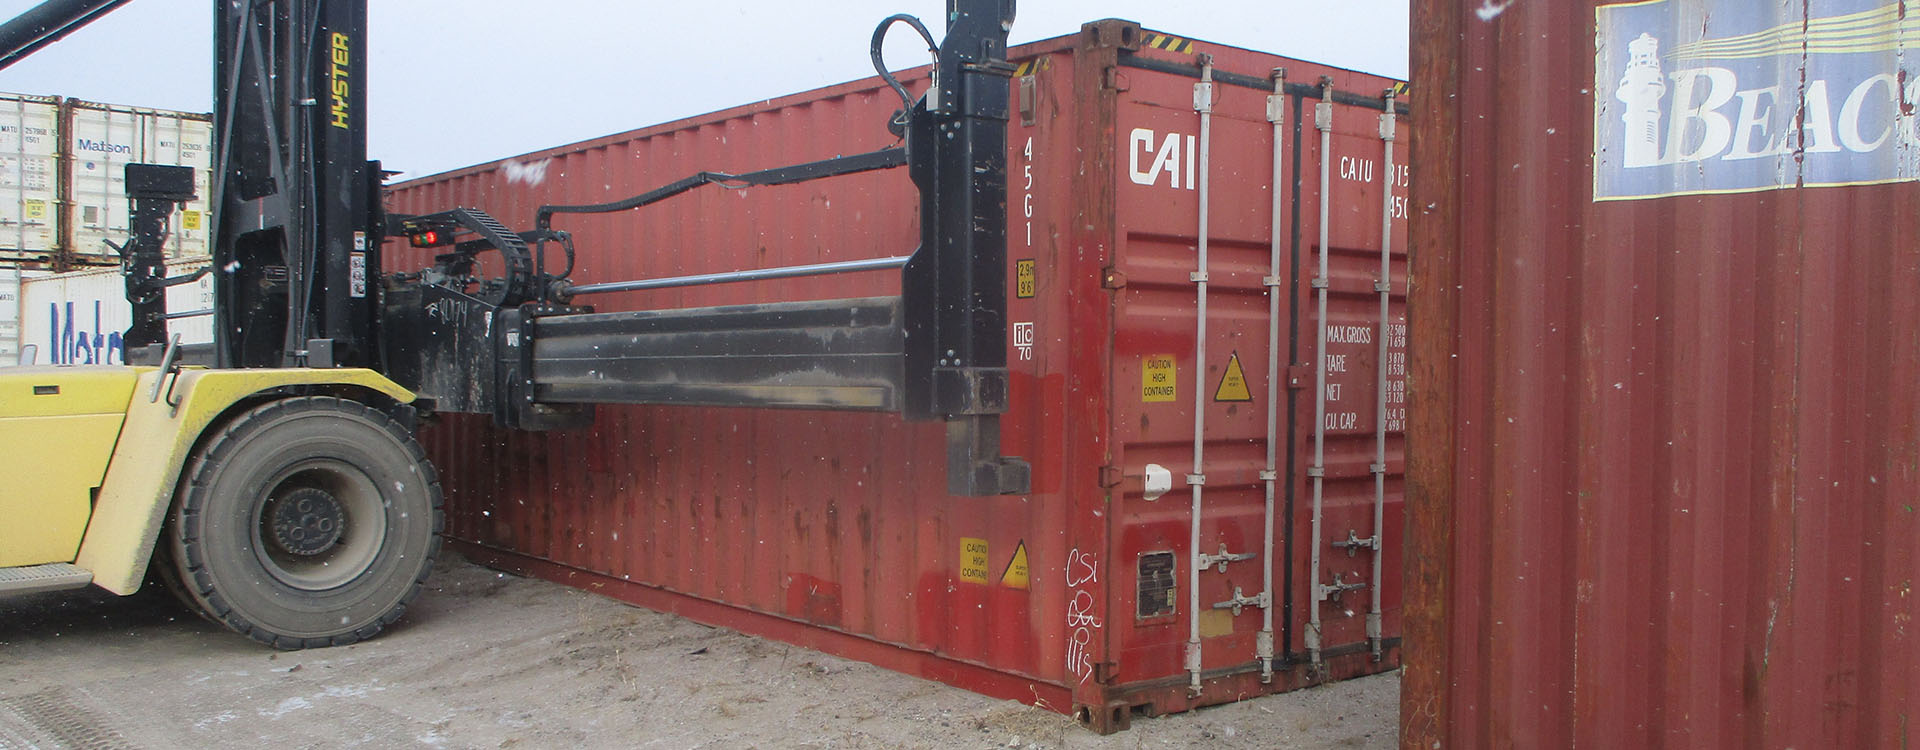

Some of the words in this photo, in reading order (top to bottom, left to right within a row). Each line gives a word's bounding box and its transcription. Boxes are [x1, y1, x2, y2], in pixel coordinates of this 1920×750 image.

[331, 32, 349, 129] HYSTER
[79, 139, 131, 155] Matson
[1129, 128, 1195, 190] CAI
[1340, 156, 1373, 183] CAIU
[1018, 346, 1032, 360] 70
[1147, 360, 1171, 369] CAUTION
[1327, 354, 1346, 372] TARE
[1152, 373, 1166, 382] HIGH
[1144, 386, 1174, 396] CONTAINER
[1326, 384, 1341, 401] NET
[1340, 412, 1357, 430] CAP.
